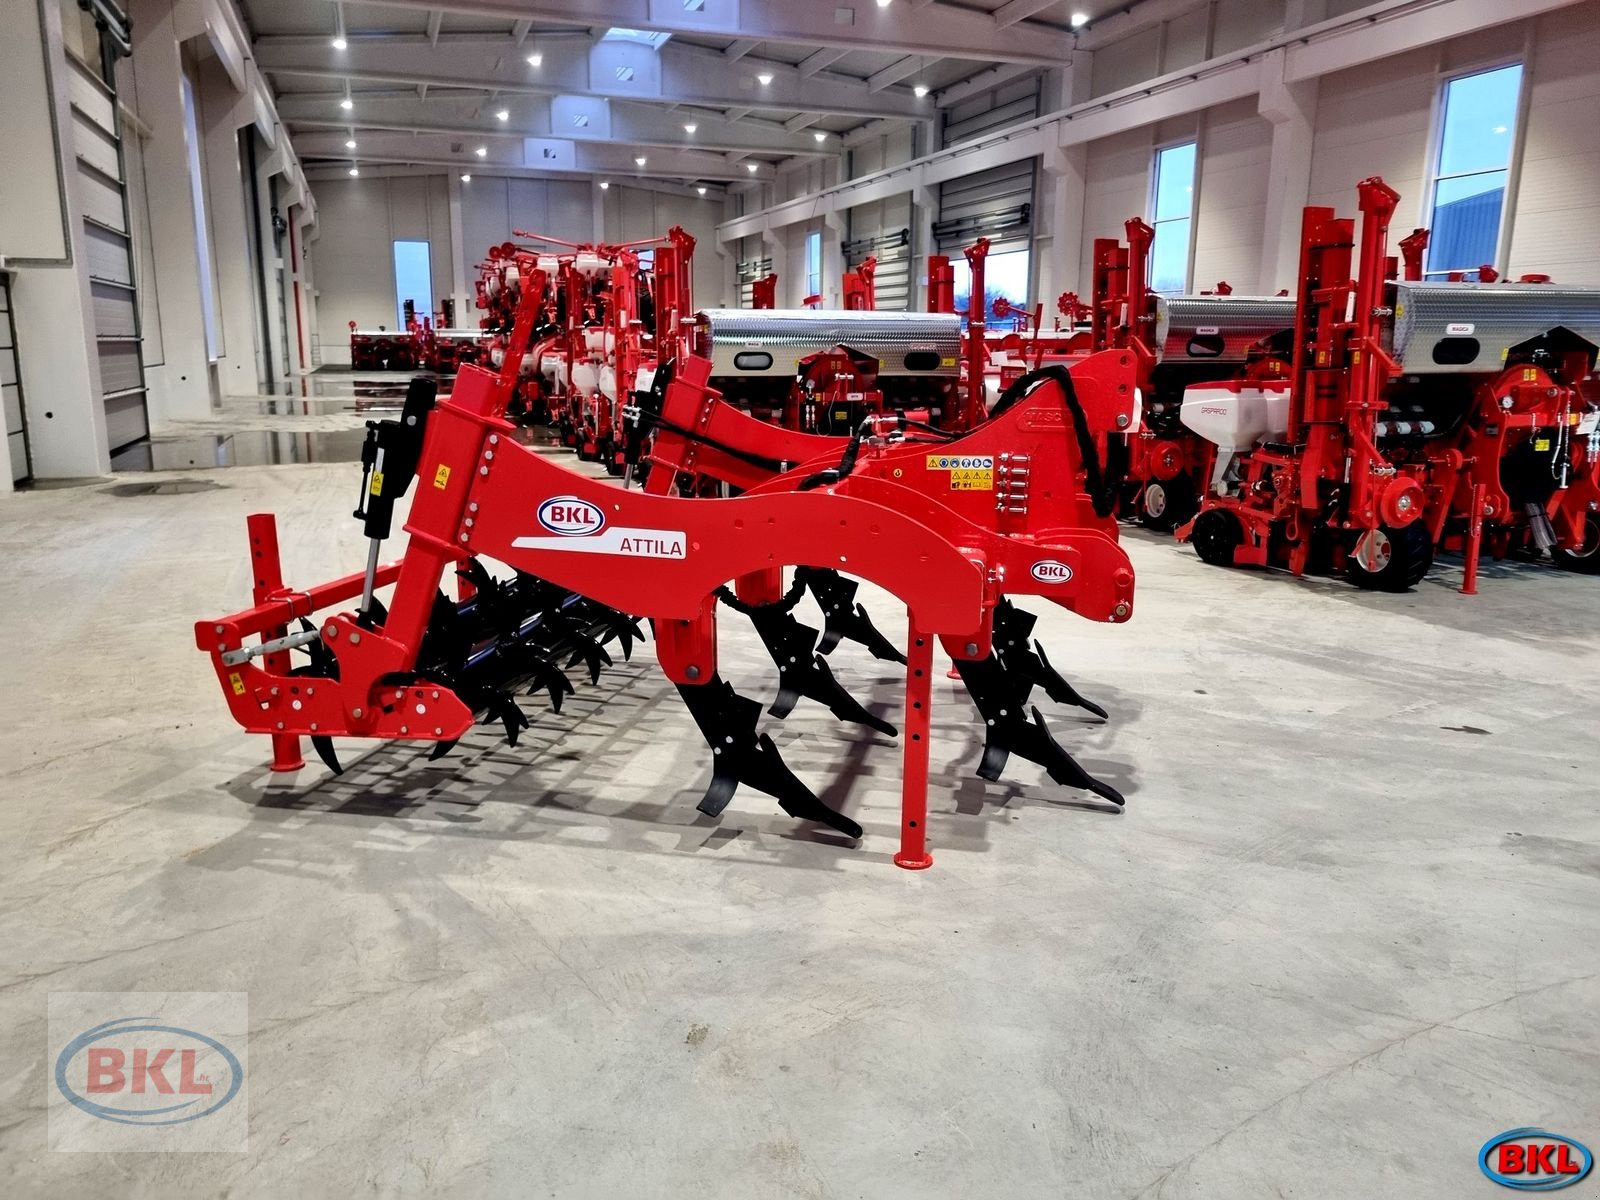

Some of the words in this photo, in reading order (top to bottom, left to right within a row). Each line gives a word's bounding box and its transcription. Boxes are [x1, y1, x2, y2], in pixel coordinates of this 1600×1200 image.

[550, 505, 596, 525] BKL
[620, 537, 683, 556] ATTILA
[1039, 565, 1067, 577] BKL
